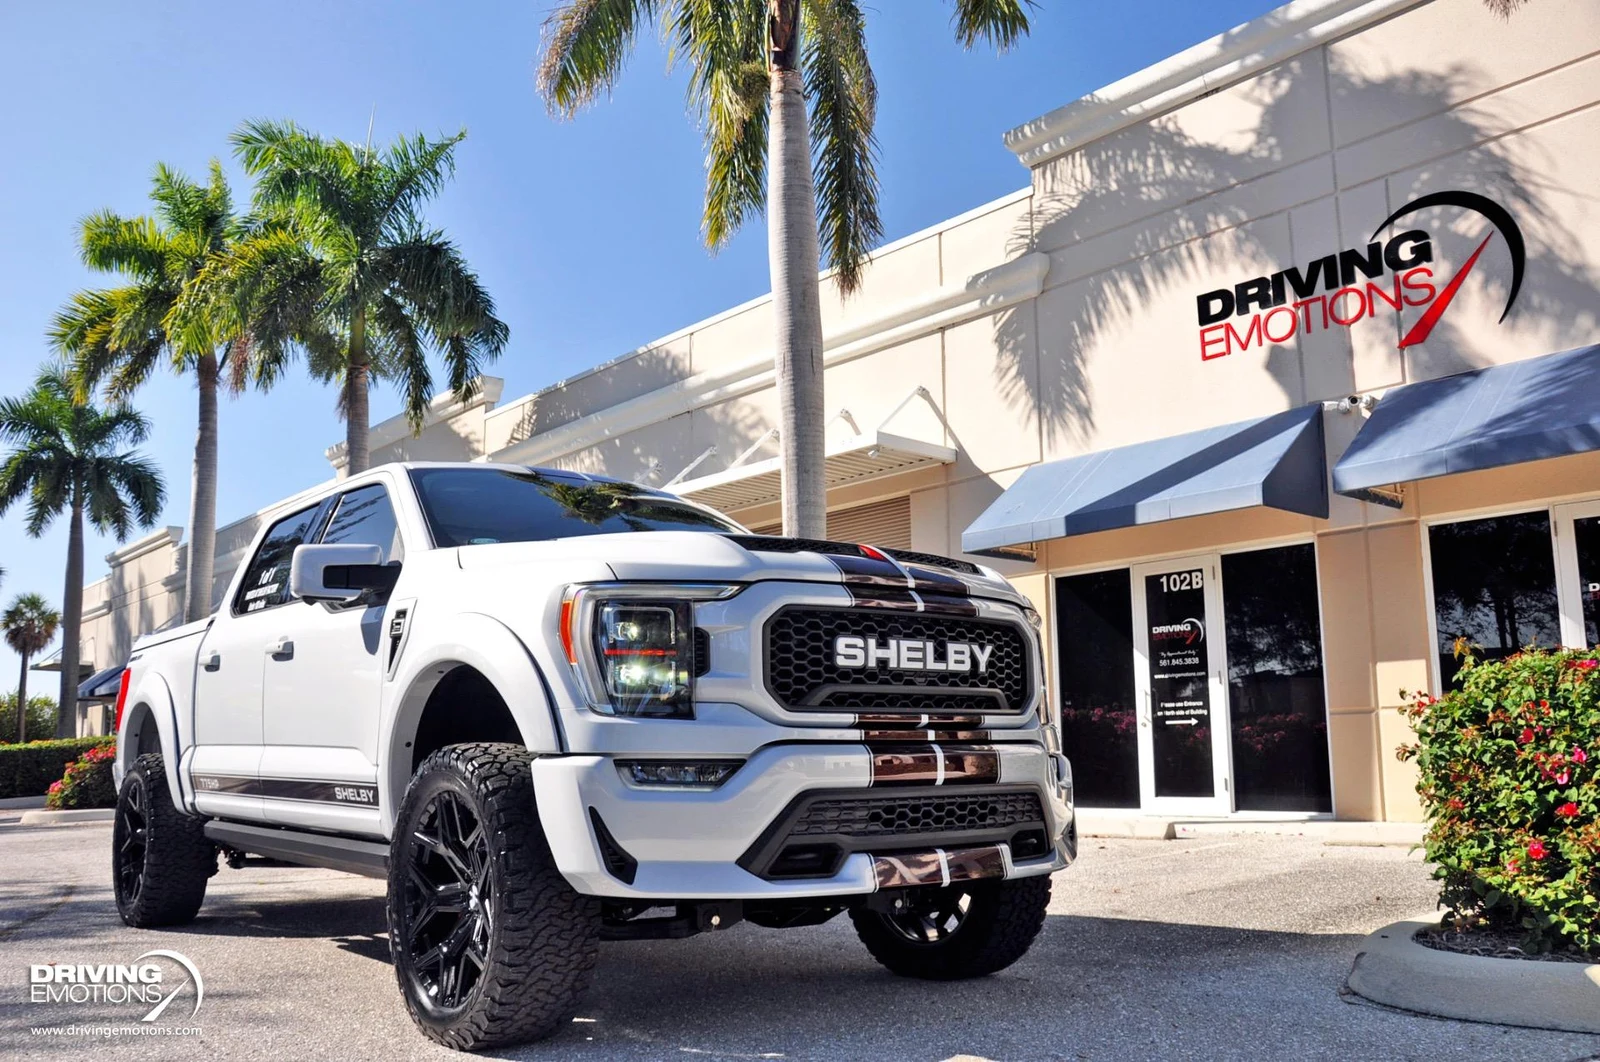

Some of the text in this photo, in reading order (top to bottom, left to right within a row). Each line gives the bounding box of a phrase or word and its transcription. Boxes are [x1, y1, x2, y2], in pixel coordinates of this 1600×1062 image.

[1197, 229, 1434, 327] DRIVING
[1199, 267, 1437, 361] EMOTIONS
[1160, 571, 1203, 593] 102B
[1152, 623, 1191, 634] DRIVING
[835, 636, 994, 673] SHELBY
[200, 778, 220, 789] 775HP
[334, 787, 374, 803] SHELBY
